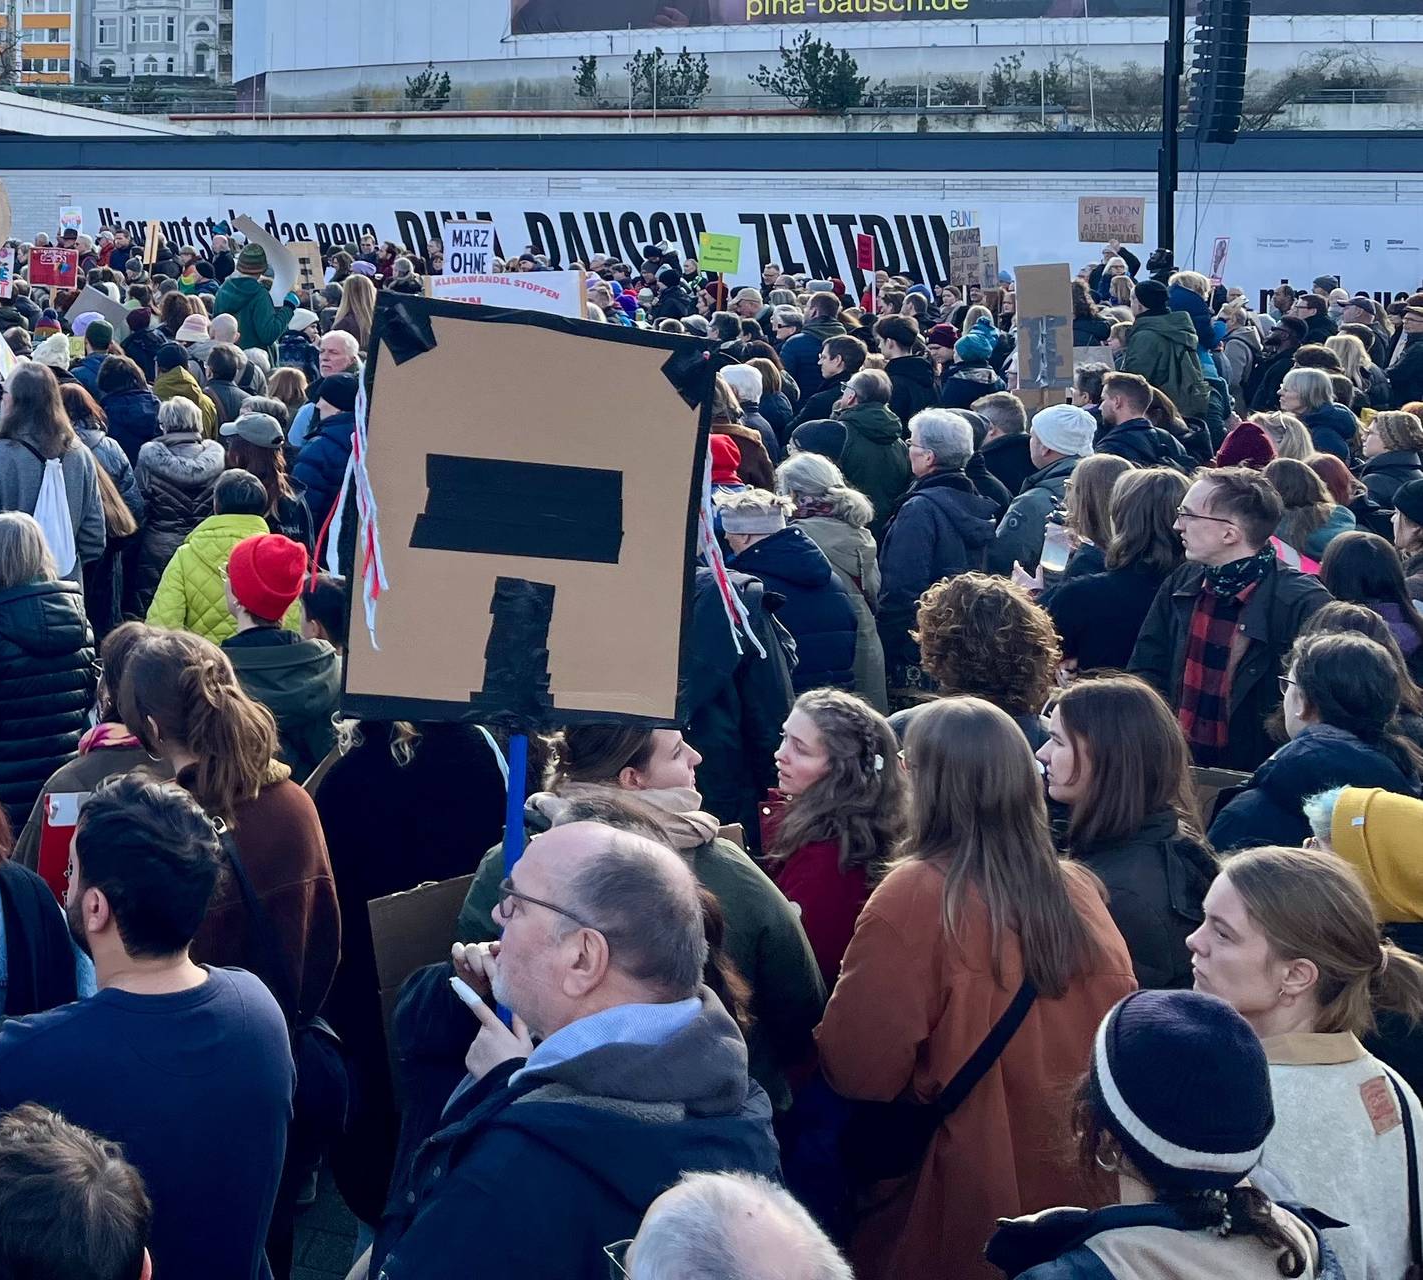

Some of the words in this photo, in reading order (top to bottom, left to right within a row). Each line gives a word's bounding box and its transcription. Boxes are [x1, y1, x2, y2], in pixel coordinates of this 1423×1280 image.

[745, 0, 969, 21] pina-bausch.de
[1083, 205, 1101, 215] DIE
[1107, 205, 1140, 215] UNION
[1082, 223, 1138, 233] ALTERNATIVE
[452, 229, 489, 248] MÄRZ
[450, 252, 488, 274] OHNE
[434, 275, 512, 287] KLIMAWANDEL
[514, 279, 560, 300] STOPPEN
